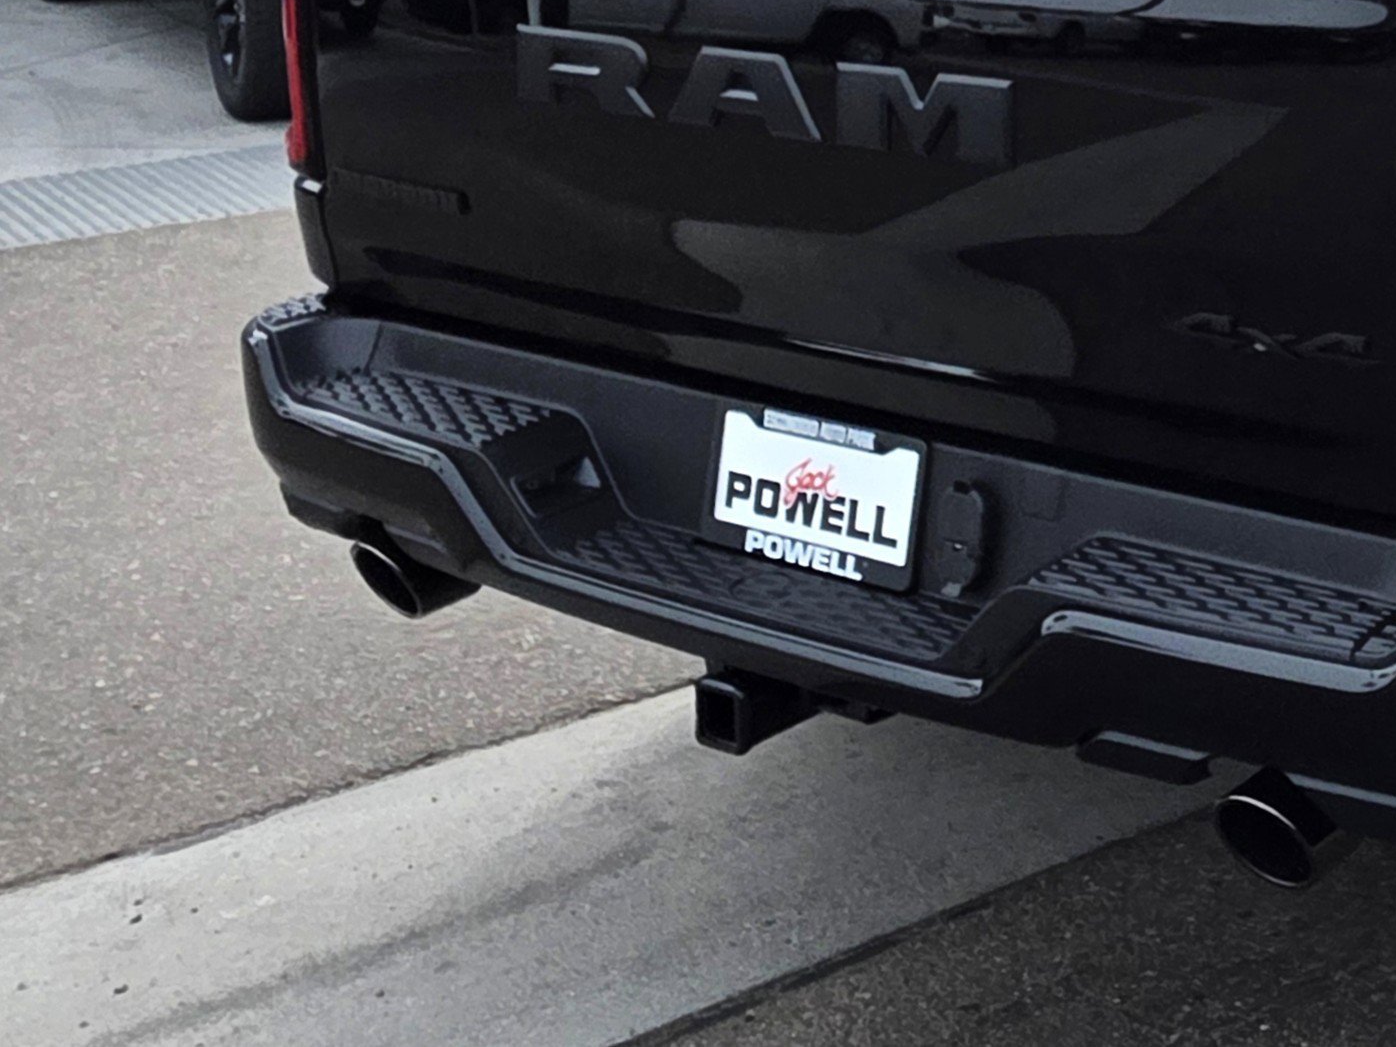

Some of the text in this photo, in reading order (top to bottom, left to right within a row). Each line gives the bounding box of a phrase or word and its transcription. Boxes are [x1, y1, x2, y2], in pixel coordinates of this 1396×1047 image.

[516, 23, 1015, 166] RAM
[725, 470, 897, 549] POWELL
[745, 528, 863, 581] POWELL
